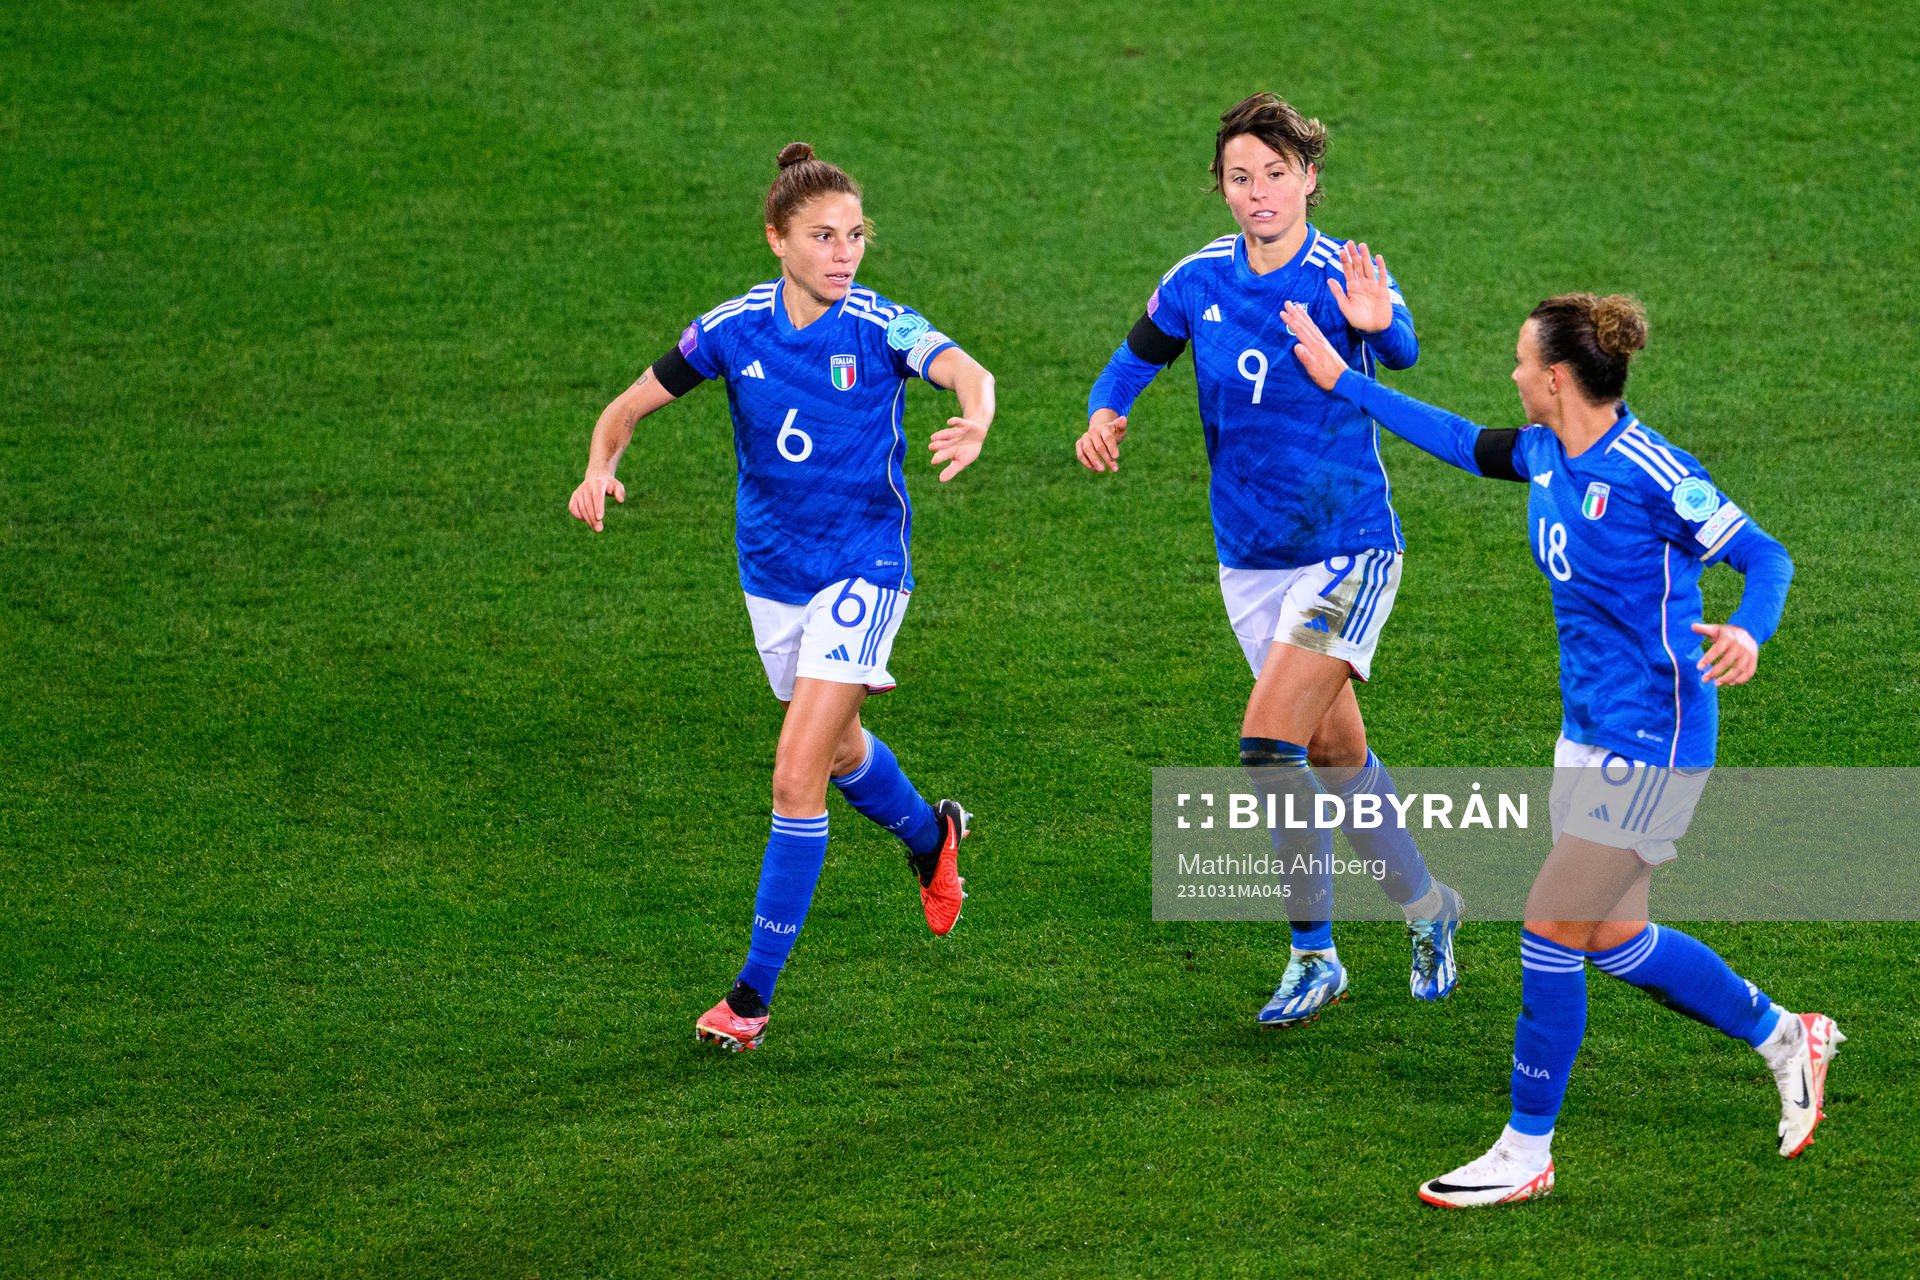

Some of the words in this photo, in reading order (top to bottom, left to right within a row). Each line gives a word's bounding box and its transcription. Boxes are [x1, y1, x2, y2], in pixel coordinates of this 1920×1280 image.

[1237, 349, 1269, 404] 9
[776, 408, 813, 462] 6
[1538, 517, 1572, 582] 18
[831, 577, 867, 628] 6
[1318, 555, 1356, 598] 9
[754, 913, 797, 935] ITALIA
